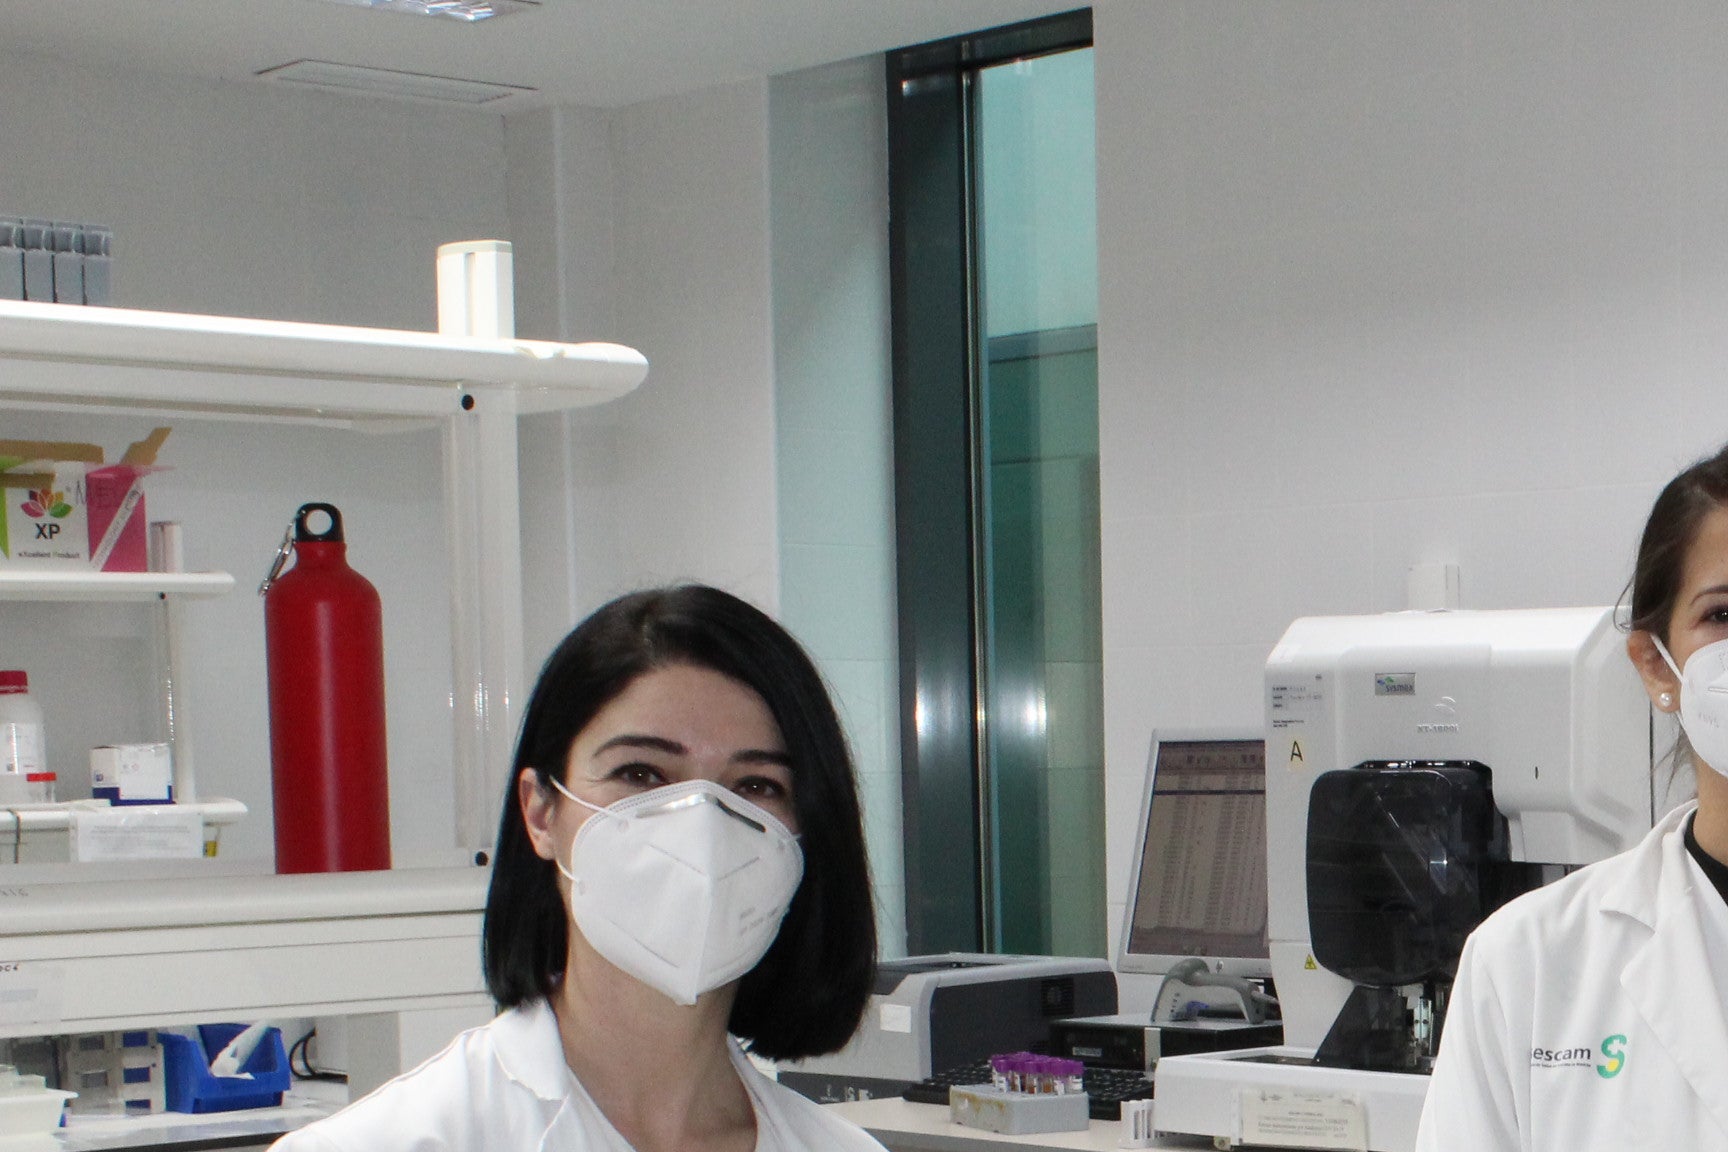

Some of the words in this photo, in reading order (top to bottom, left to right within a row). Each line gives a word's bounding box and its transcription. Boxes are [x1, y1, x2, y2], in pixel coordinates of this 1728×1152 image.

[35, 522, 61, 539] XP
[1290, 741, 1303, 761] A
[1531, 1048, 1592, 1062] escam
